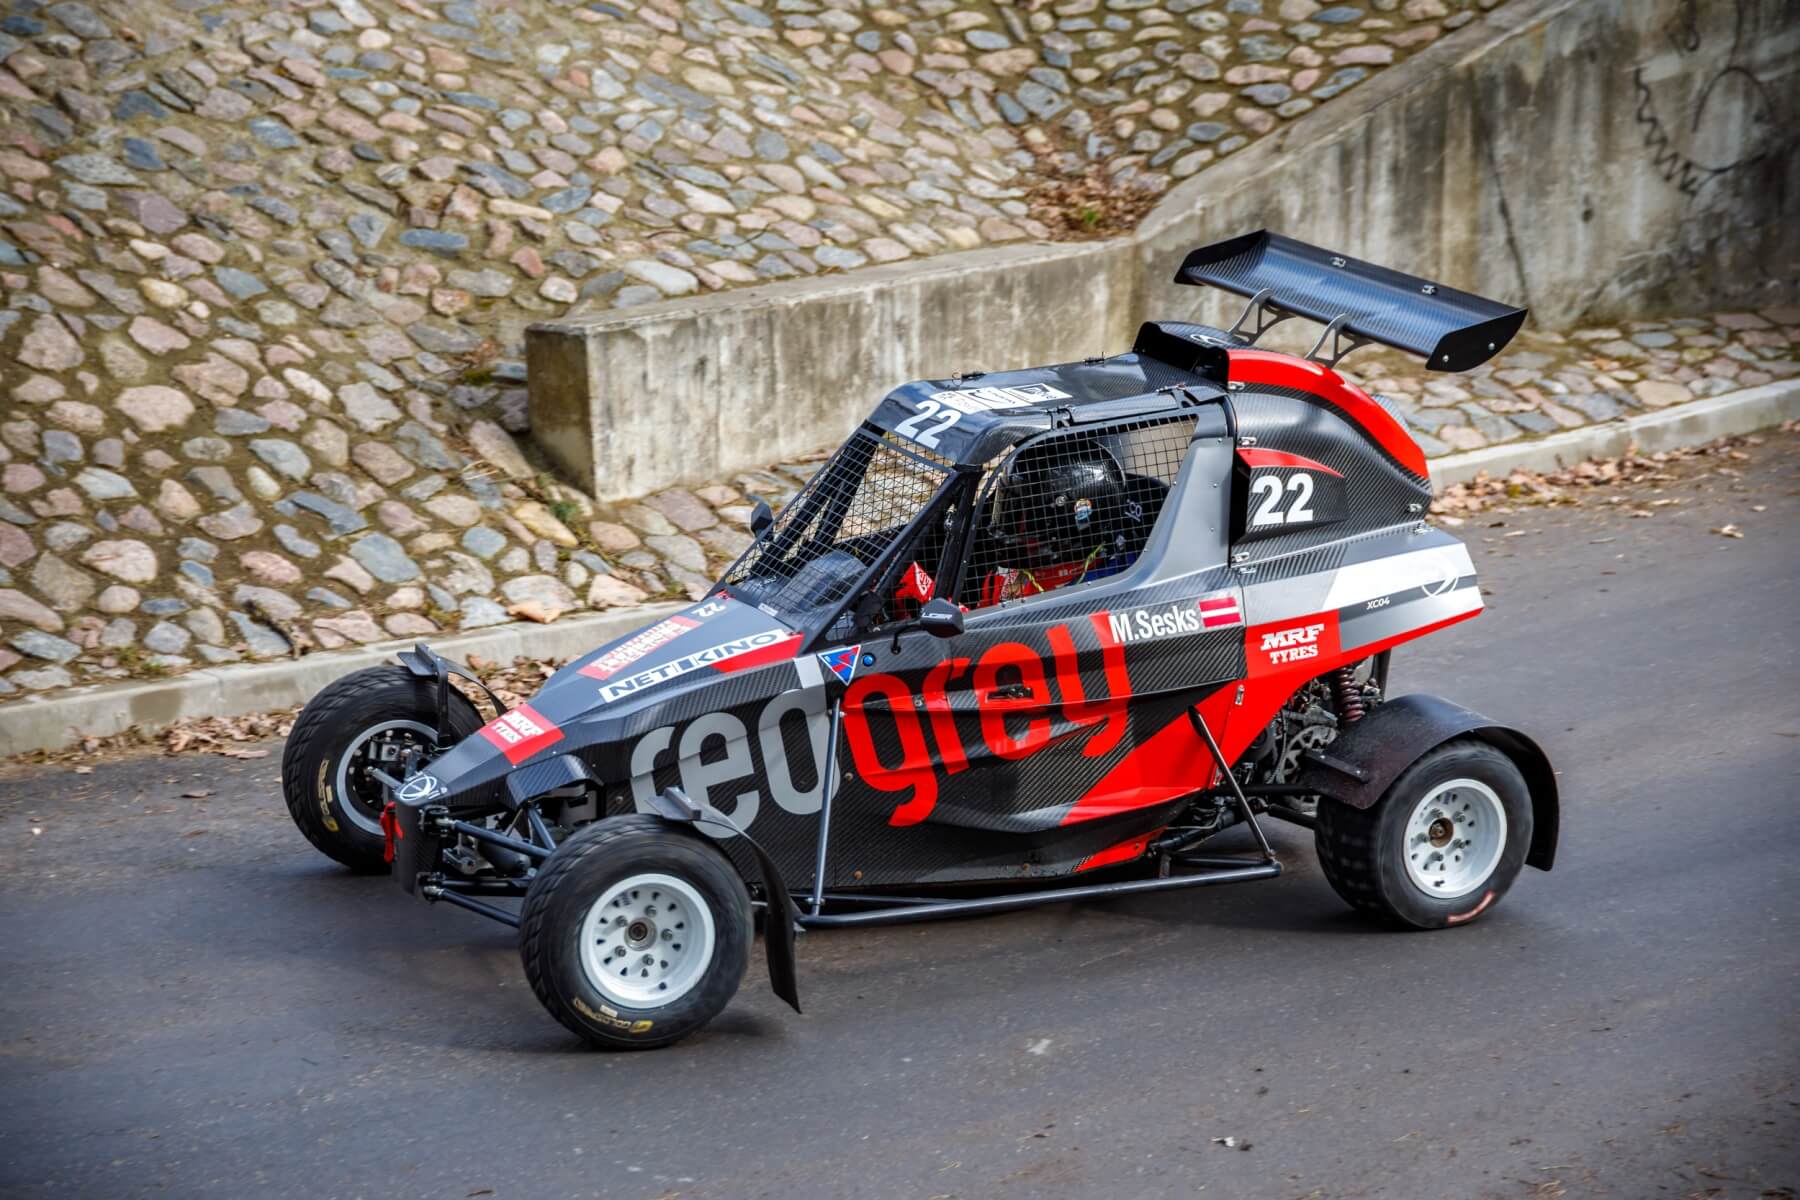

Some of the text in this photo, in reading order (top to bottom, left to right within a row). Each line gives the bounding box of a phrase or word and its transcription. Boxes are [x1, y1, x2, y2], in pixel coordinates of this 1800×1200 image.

[894, 401, 962, 448] 22
[1251, 472, 1314, 526] 22
[1108, 604, 1200, 643] M.Sesks
[1260, 624, 1325, 651] MRF
[1269, 644, 1319, 665] TYRES
